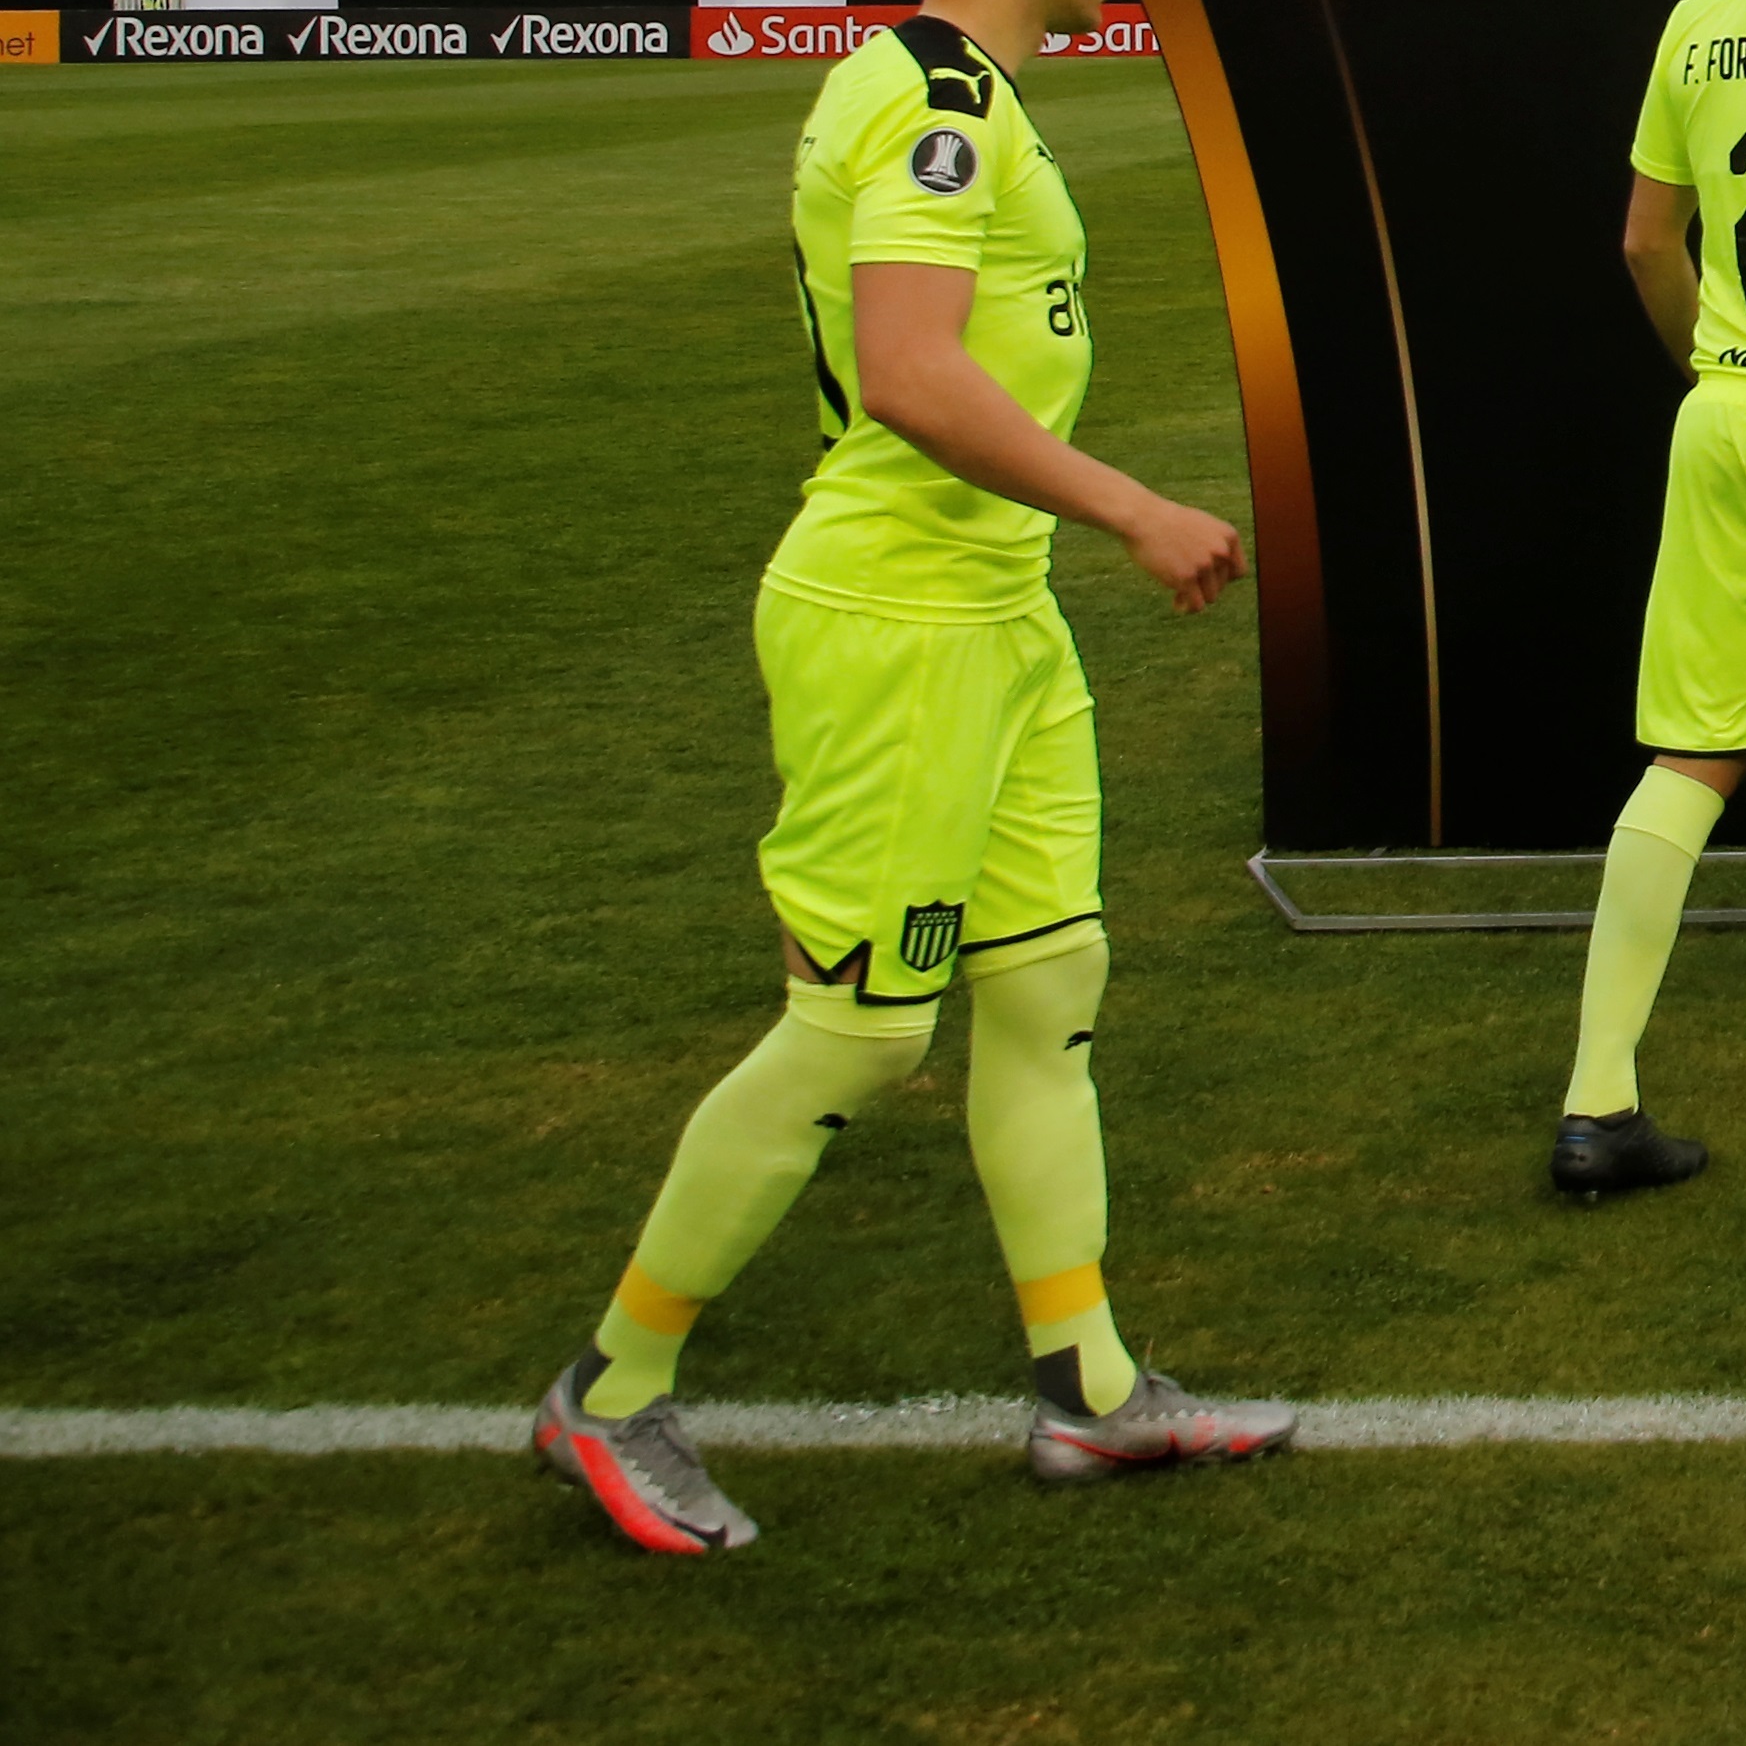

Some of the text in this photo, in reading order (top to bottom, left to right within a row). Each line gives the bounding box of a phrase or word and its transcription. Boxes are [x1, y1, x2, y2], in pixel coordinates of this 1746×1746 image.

[116, 16, 265, 56] Rexona
[319, 15, 468, 55] Rexona
[522, 14, 668, 54] Rexona
[1683, 43, 1699, 85] F.
